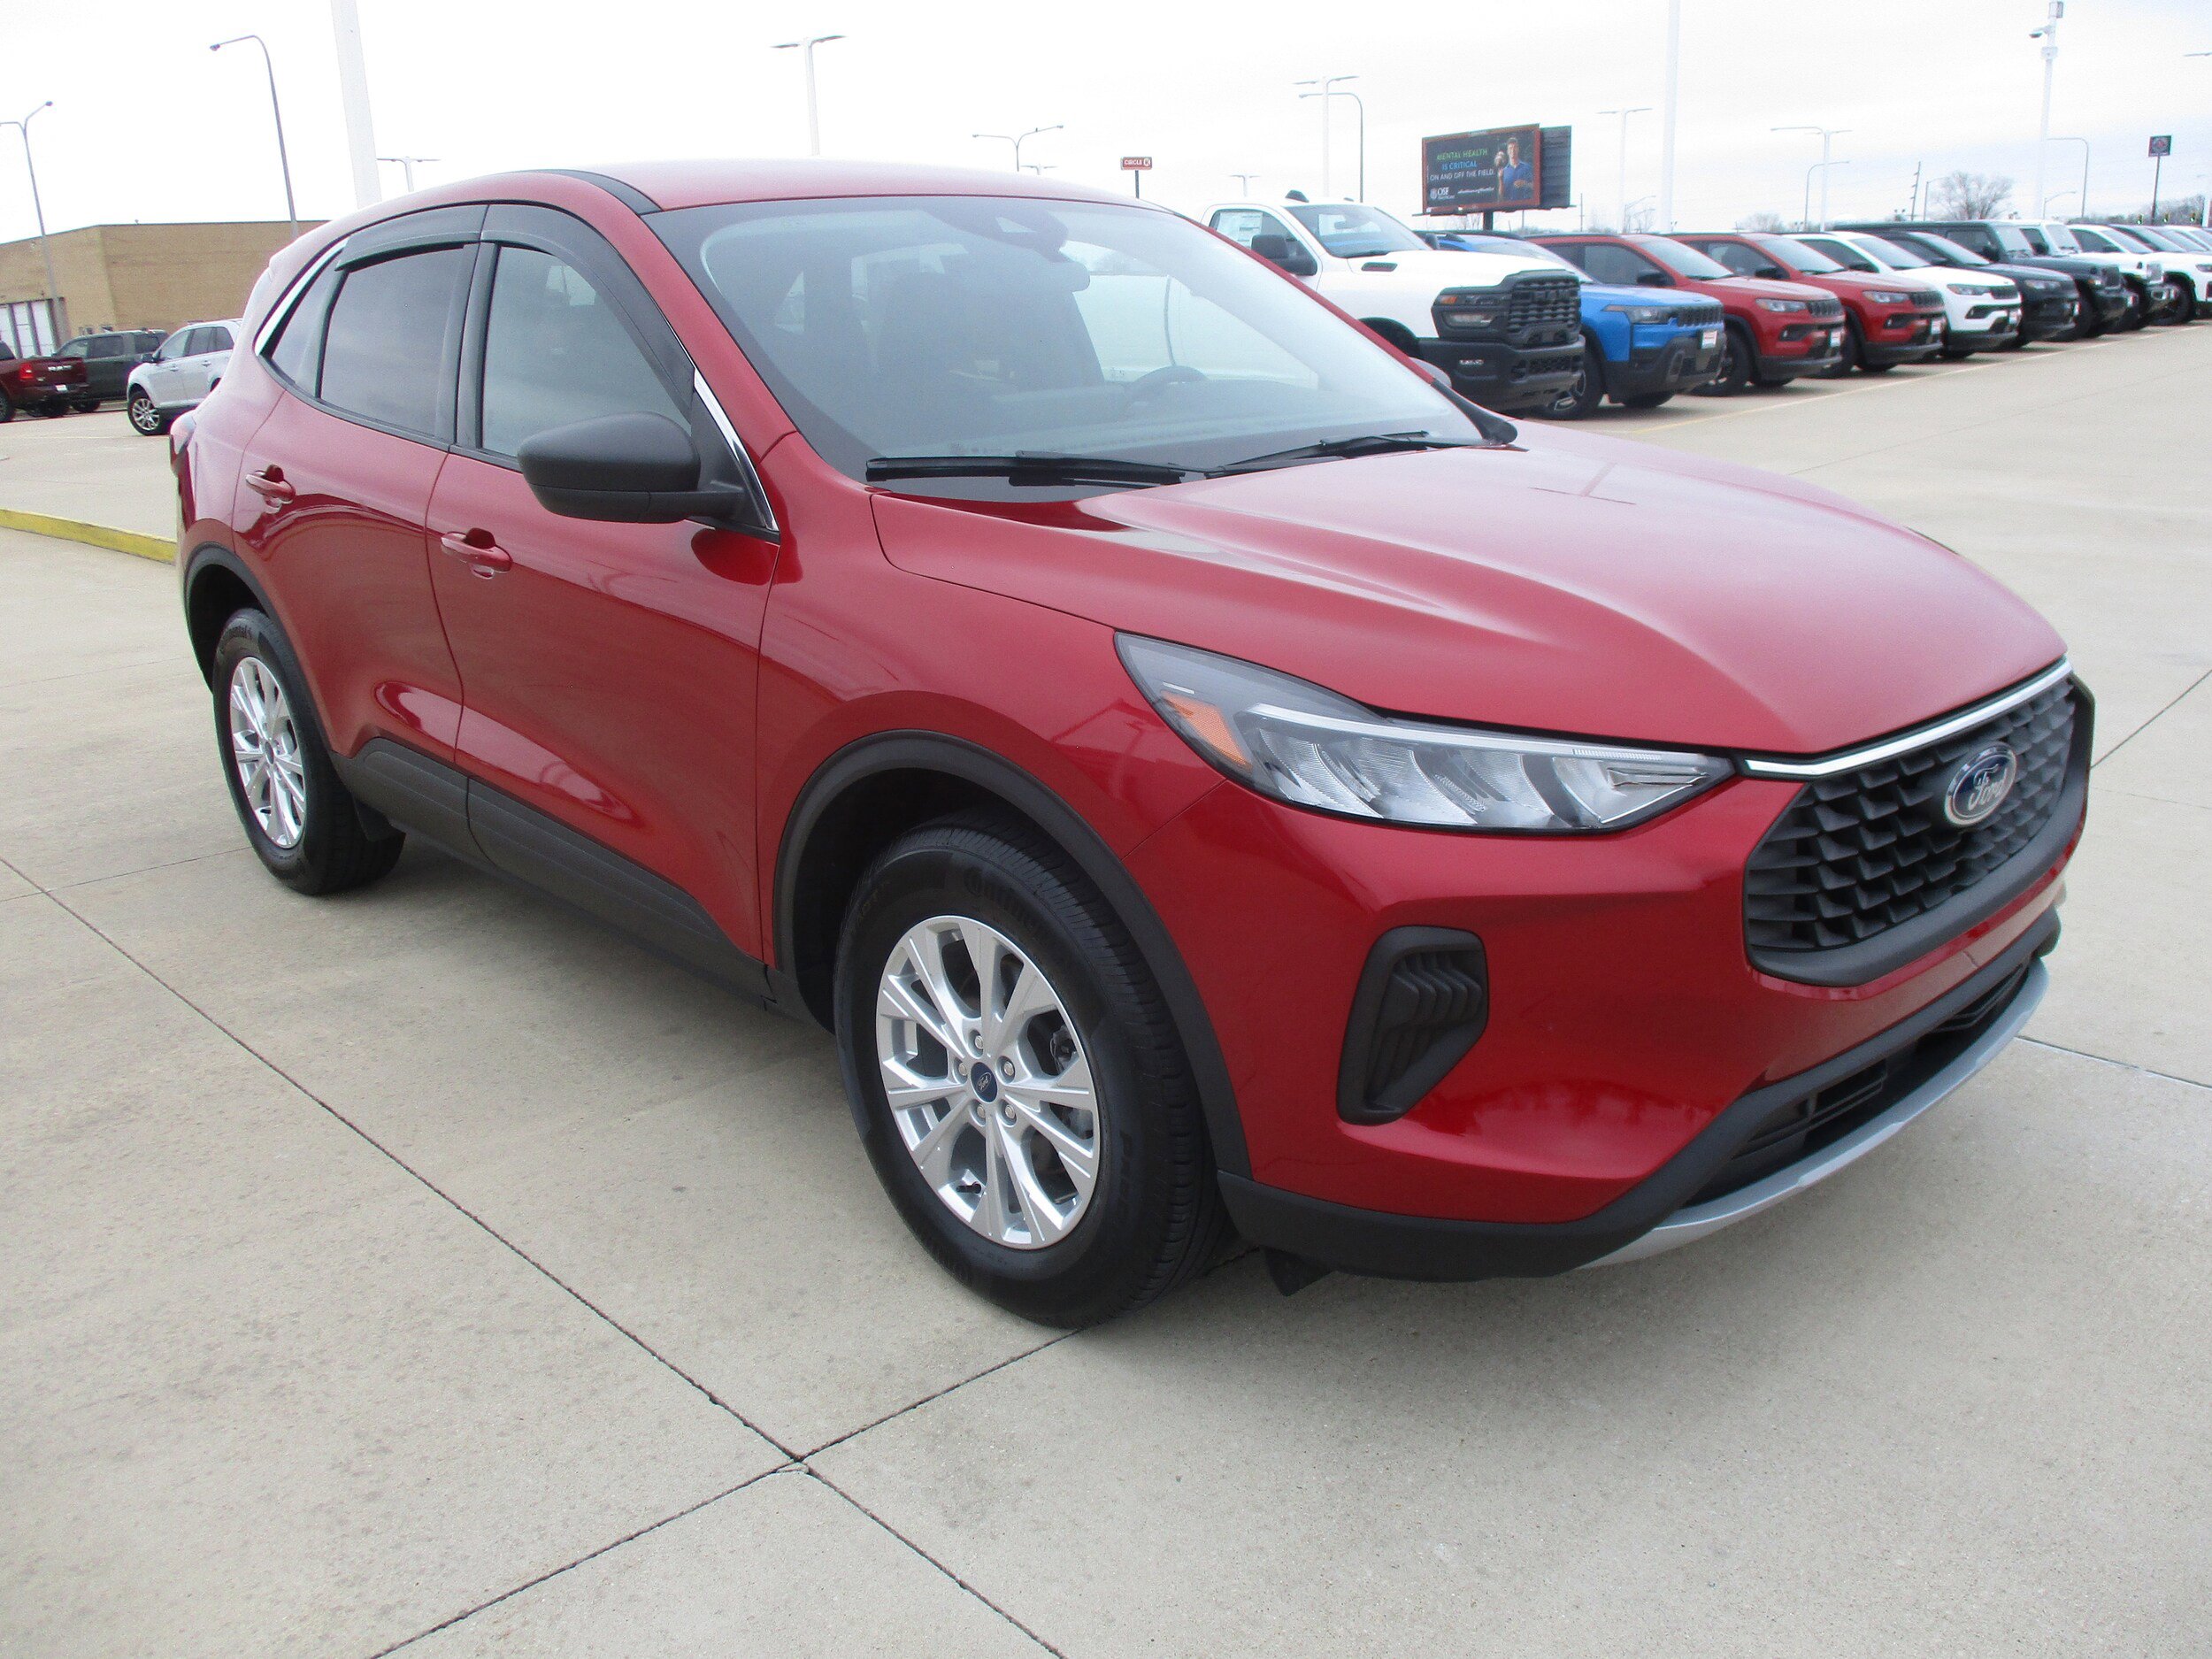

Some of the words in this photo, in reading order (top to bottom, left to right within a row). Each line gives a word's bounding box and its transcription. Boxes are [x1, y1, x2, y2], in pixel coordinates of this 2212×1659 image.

[1437, 151, 1461, 160] MENTAL
[1463, 149, 1487, 157] HEALTH
[1448, 161, 1478, 170] CRITICAL
[1968, 763, 2010, 811] Ford
